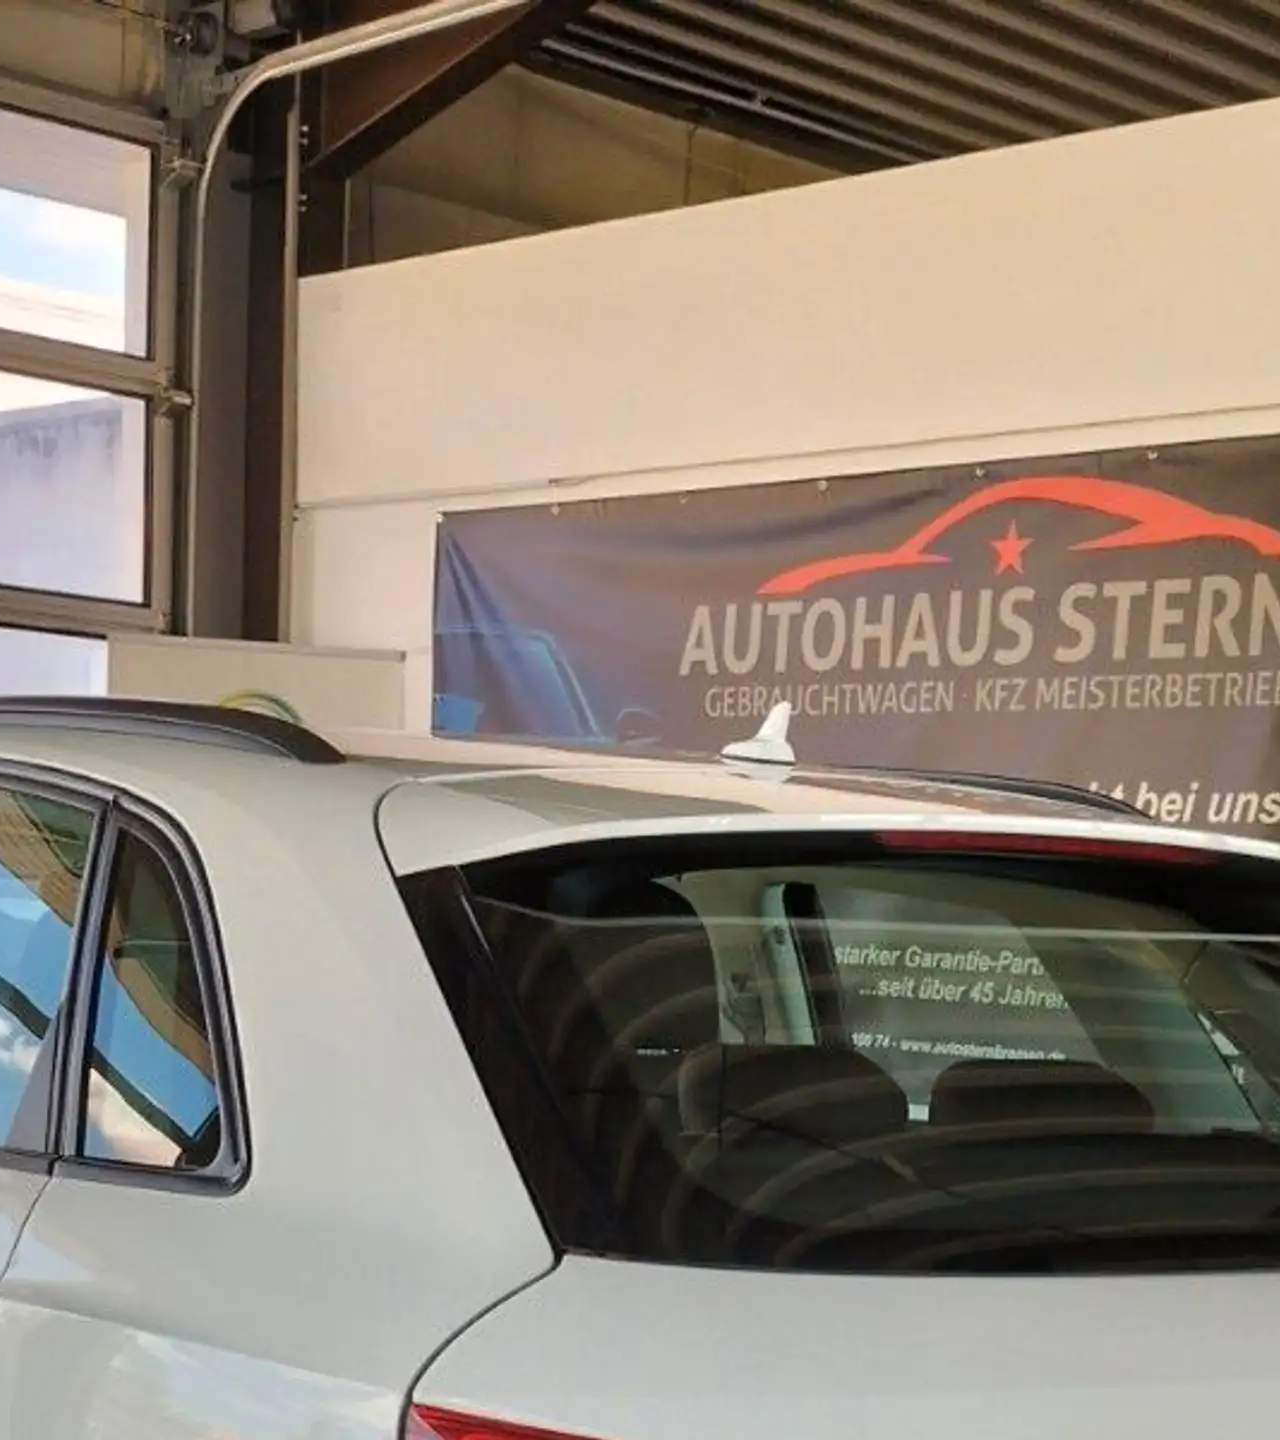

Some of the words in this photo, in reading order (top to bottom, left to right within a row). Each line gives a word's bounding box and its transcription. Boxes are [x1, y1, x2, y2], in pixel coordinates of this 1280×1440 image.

[679, 586, 1035, 676] AUTOHAUS
[705, 680, 954, 718] GEBRAUCHTWAGEN
[975, 677, 1026, 712] KFZ
[1134, 780, 1200, 823] bei
[905, 945, 1045, 976] Garantie-Part
[918, 976, 967, 1002] über
[970, 980, 994, 1004] 45
